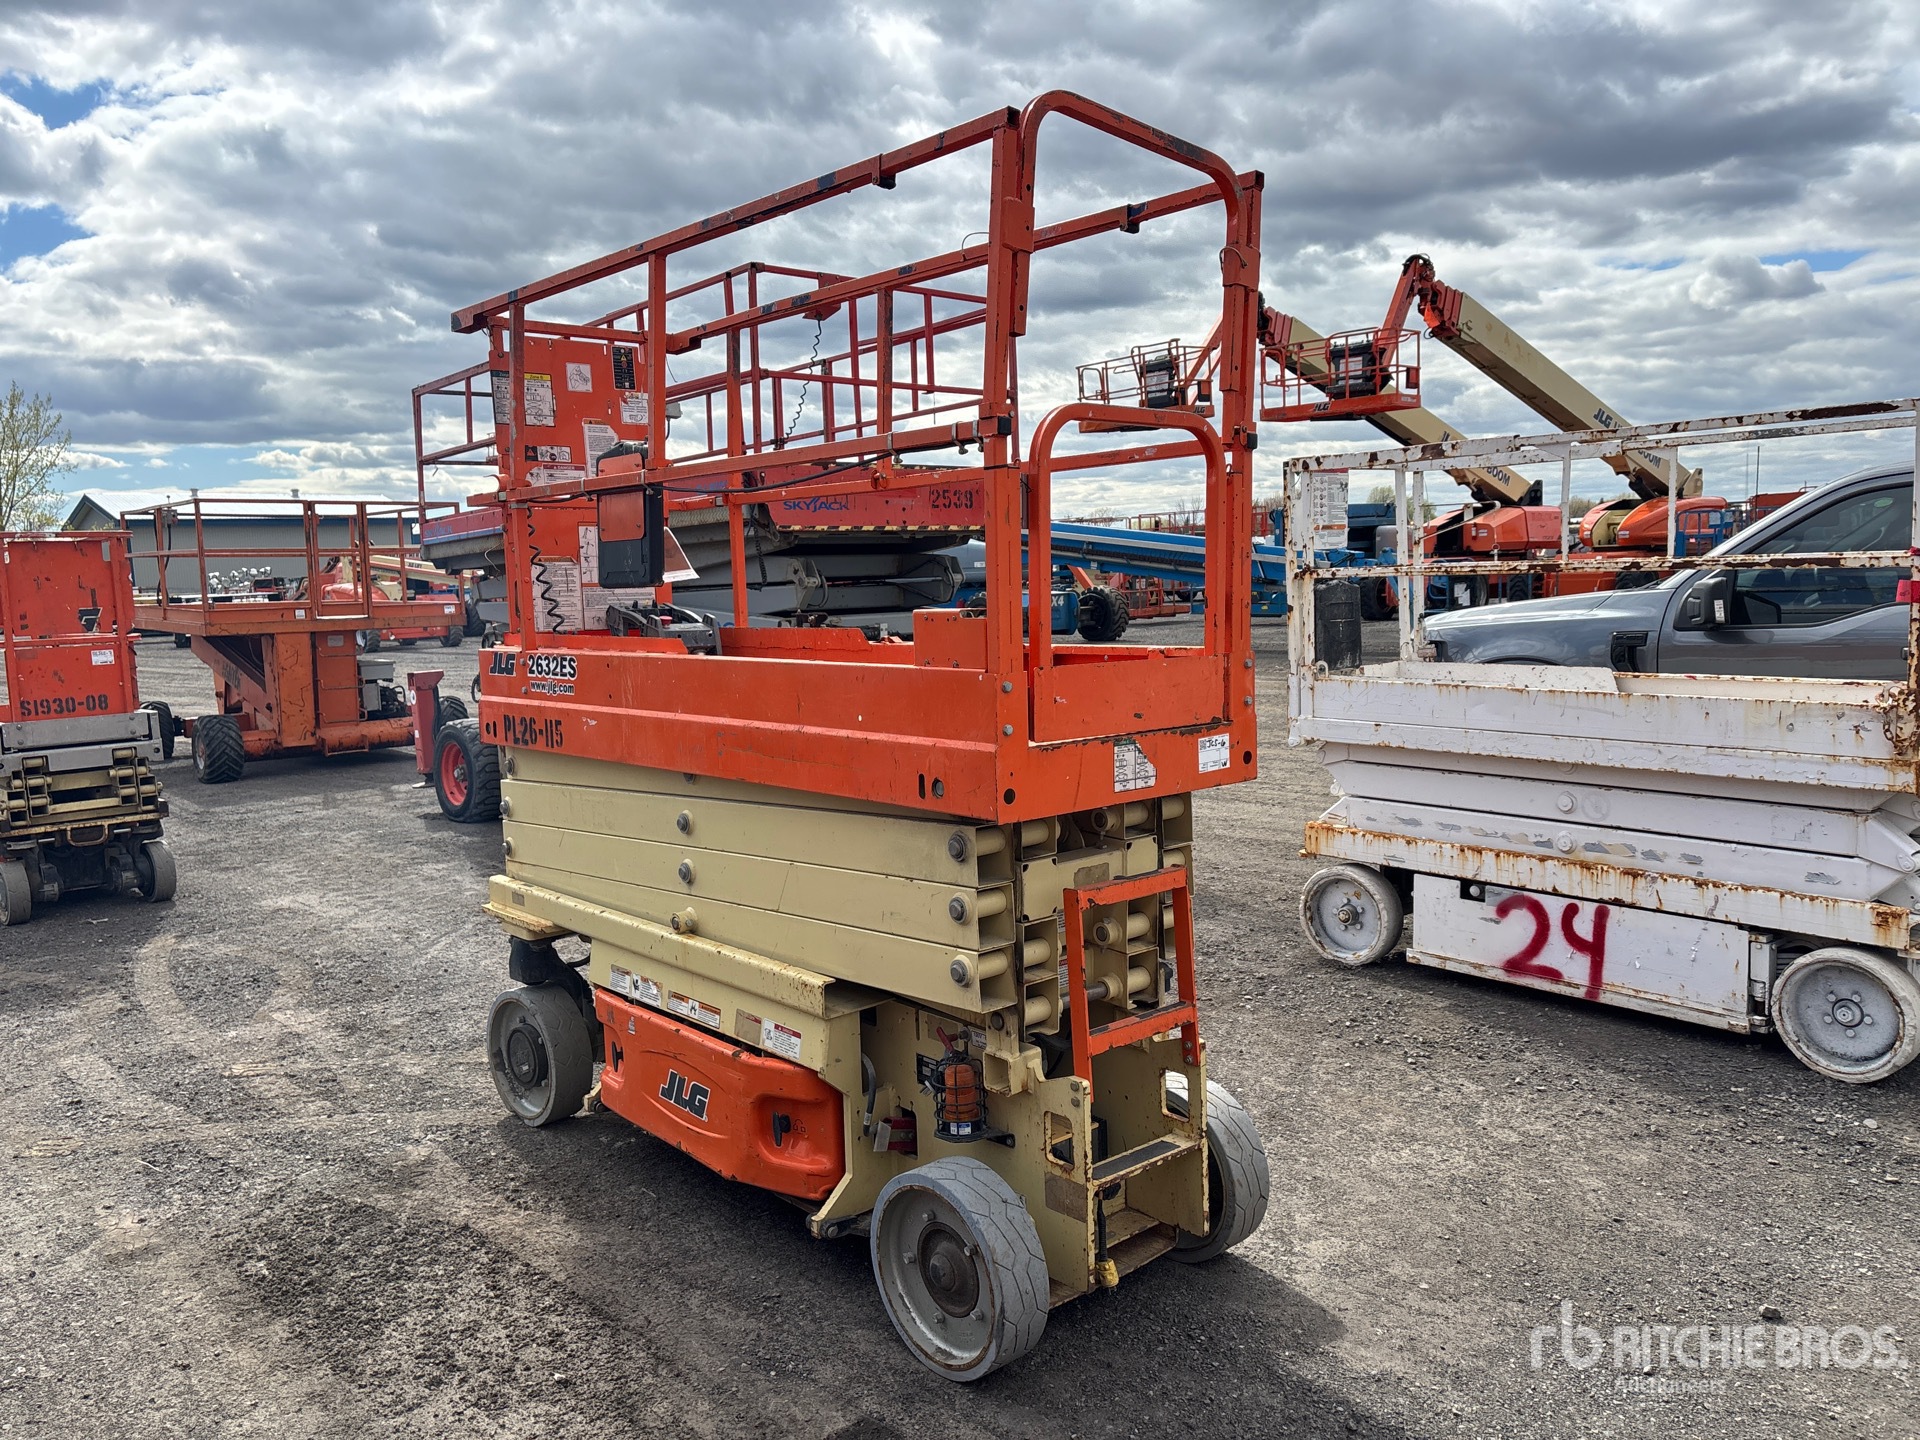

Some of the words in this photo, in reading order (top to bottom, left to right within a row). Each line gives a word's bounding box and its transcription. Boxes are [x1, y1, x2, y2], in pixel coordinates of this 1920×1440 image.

[1193, 406, 1205, 414] JLG
[1593, 407, 1613, 428] JLG
[783, 497, 849, 513] SKYJACK
[489, 652, 516, 676] JLG
[527, 654, 578, 680] 2632ES
[530, 681, 575, 695] www.jlg.com
[20, 693, 109, 717] S1930-08
[503, 714, 564, 749] PL26-115
[1495, 894, 1610, 1001] 24
[659, 1069, 710, 1121] JLG
